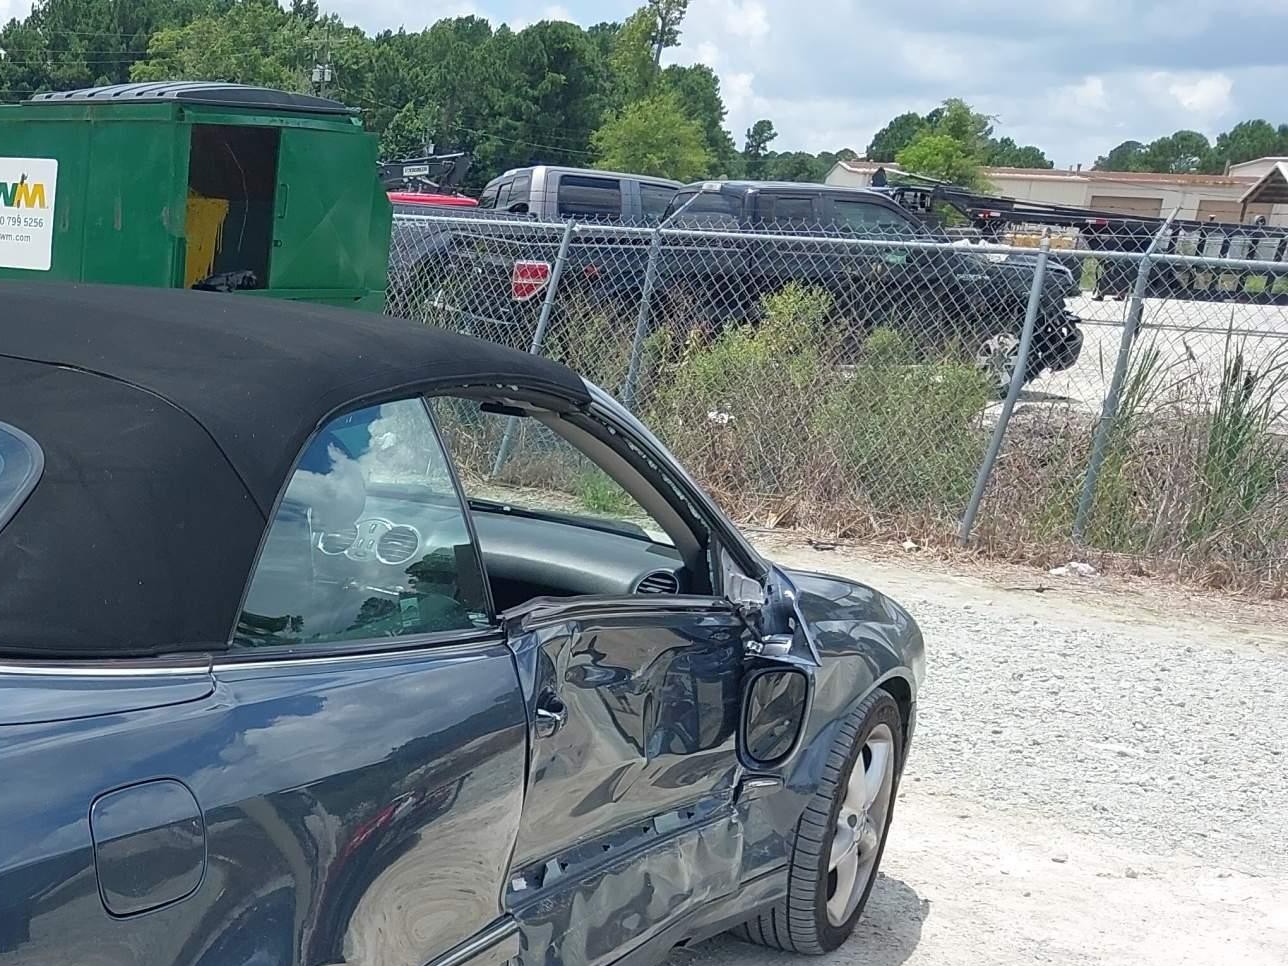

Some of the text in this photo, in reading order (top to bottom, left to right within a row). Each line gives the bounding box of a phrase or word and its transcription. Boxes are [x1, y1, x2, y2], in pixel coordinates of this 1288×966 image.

[7, 216, 21, 226] 799
[24, 218, 43, 227] 5256
[0, 232, 31, 242] wm.com
